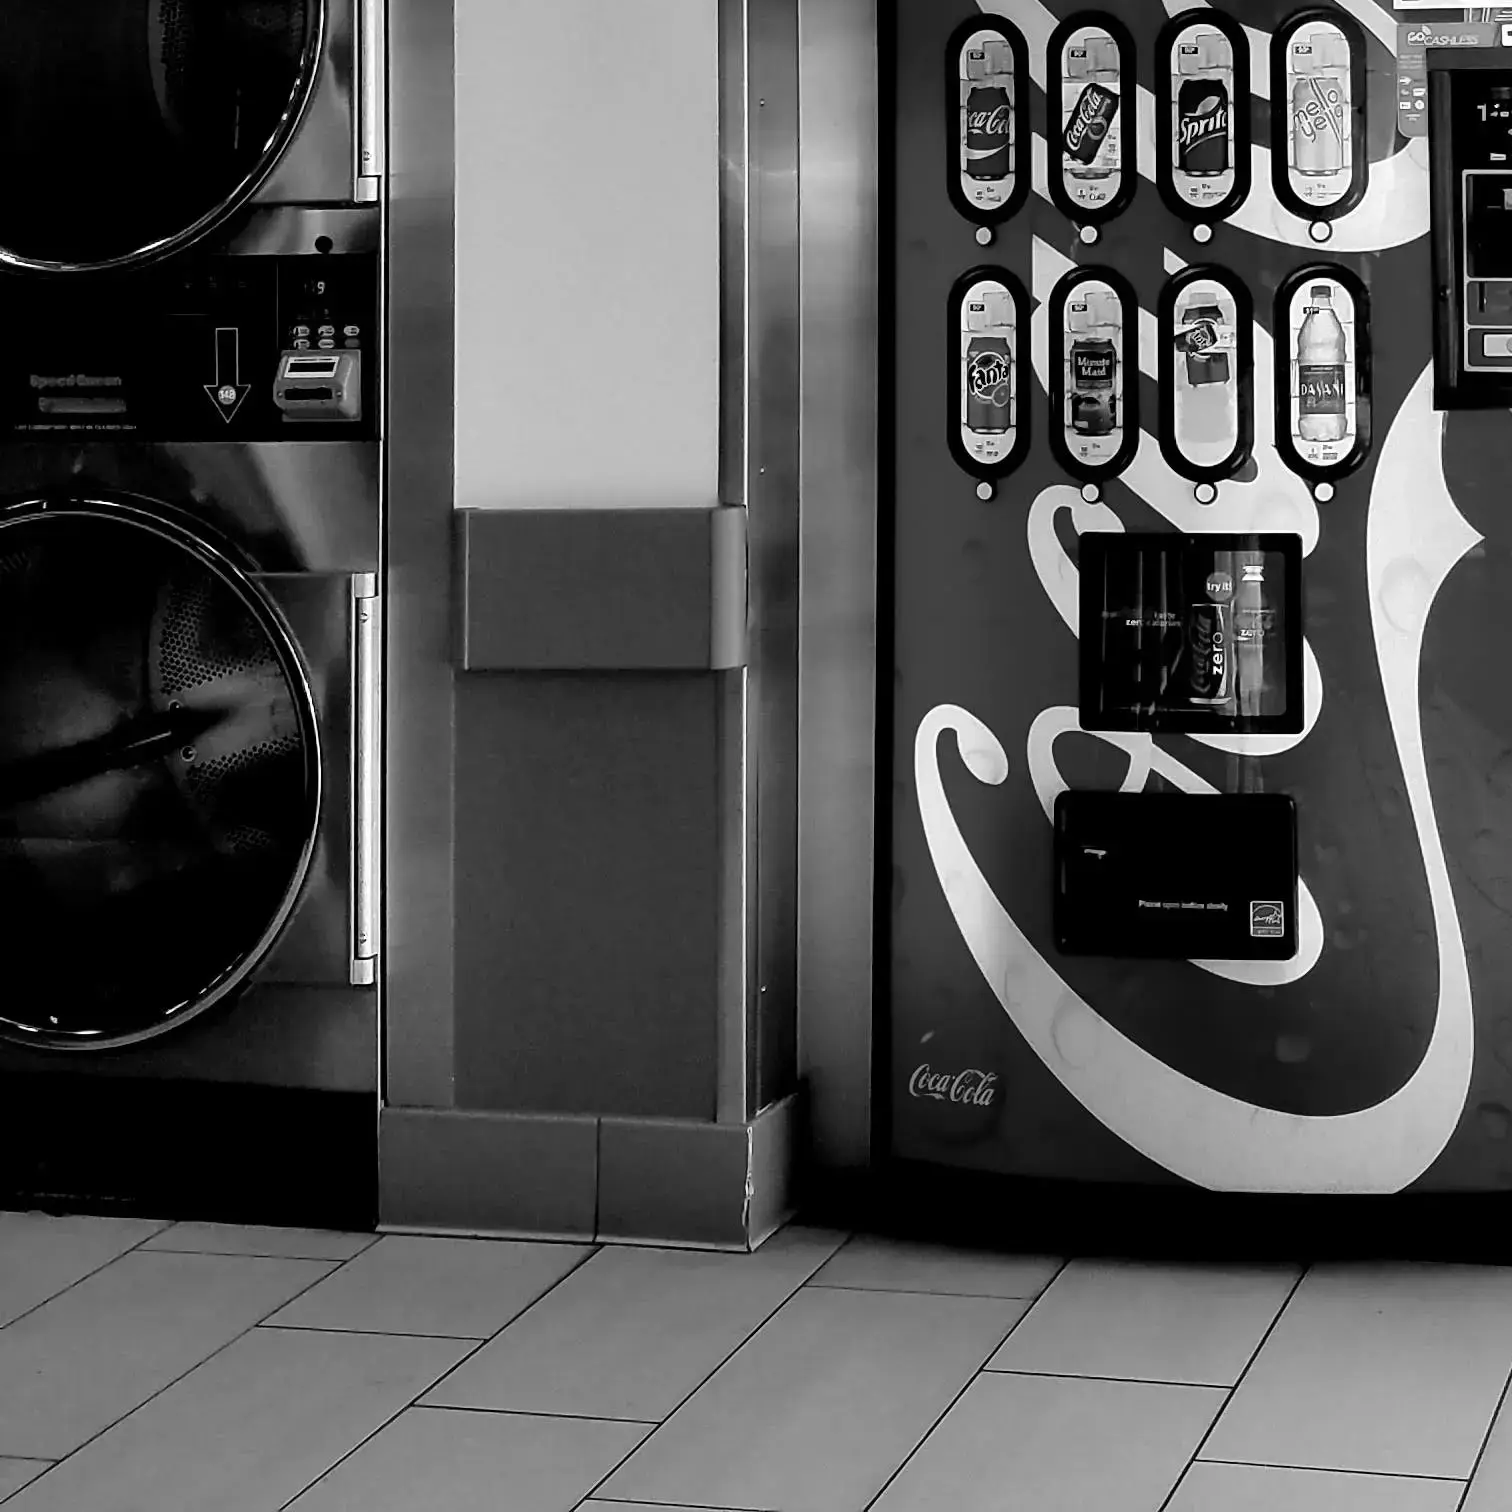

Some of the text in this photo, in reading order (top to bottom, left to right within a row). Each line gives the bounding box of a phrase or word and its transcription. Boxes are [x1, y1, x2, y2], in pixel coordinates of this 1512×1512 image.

[1077, 356, 1110, 367] Minute
[1081, 366, 1107, 377] Maid
[1300, 377, 1345, 397] DASANI
[1212, 632, 1224, 676] zero
[909, 1064, 999, 1106] Coca-Cola
